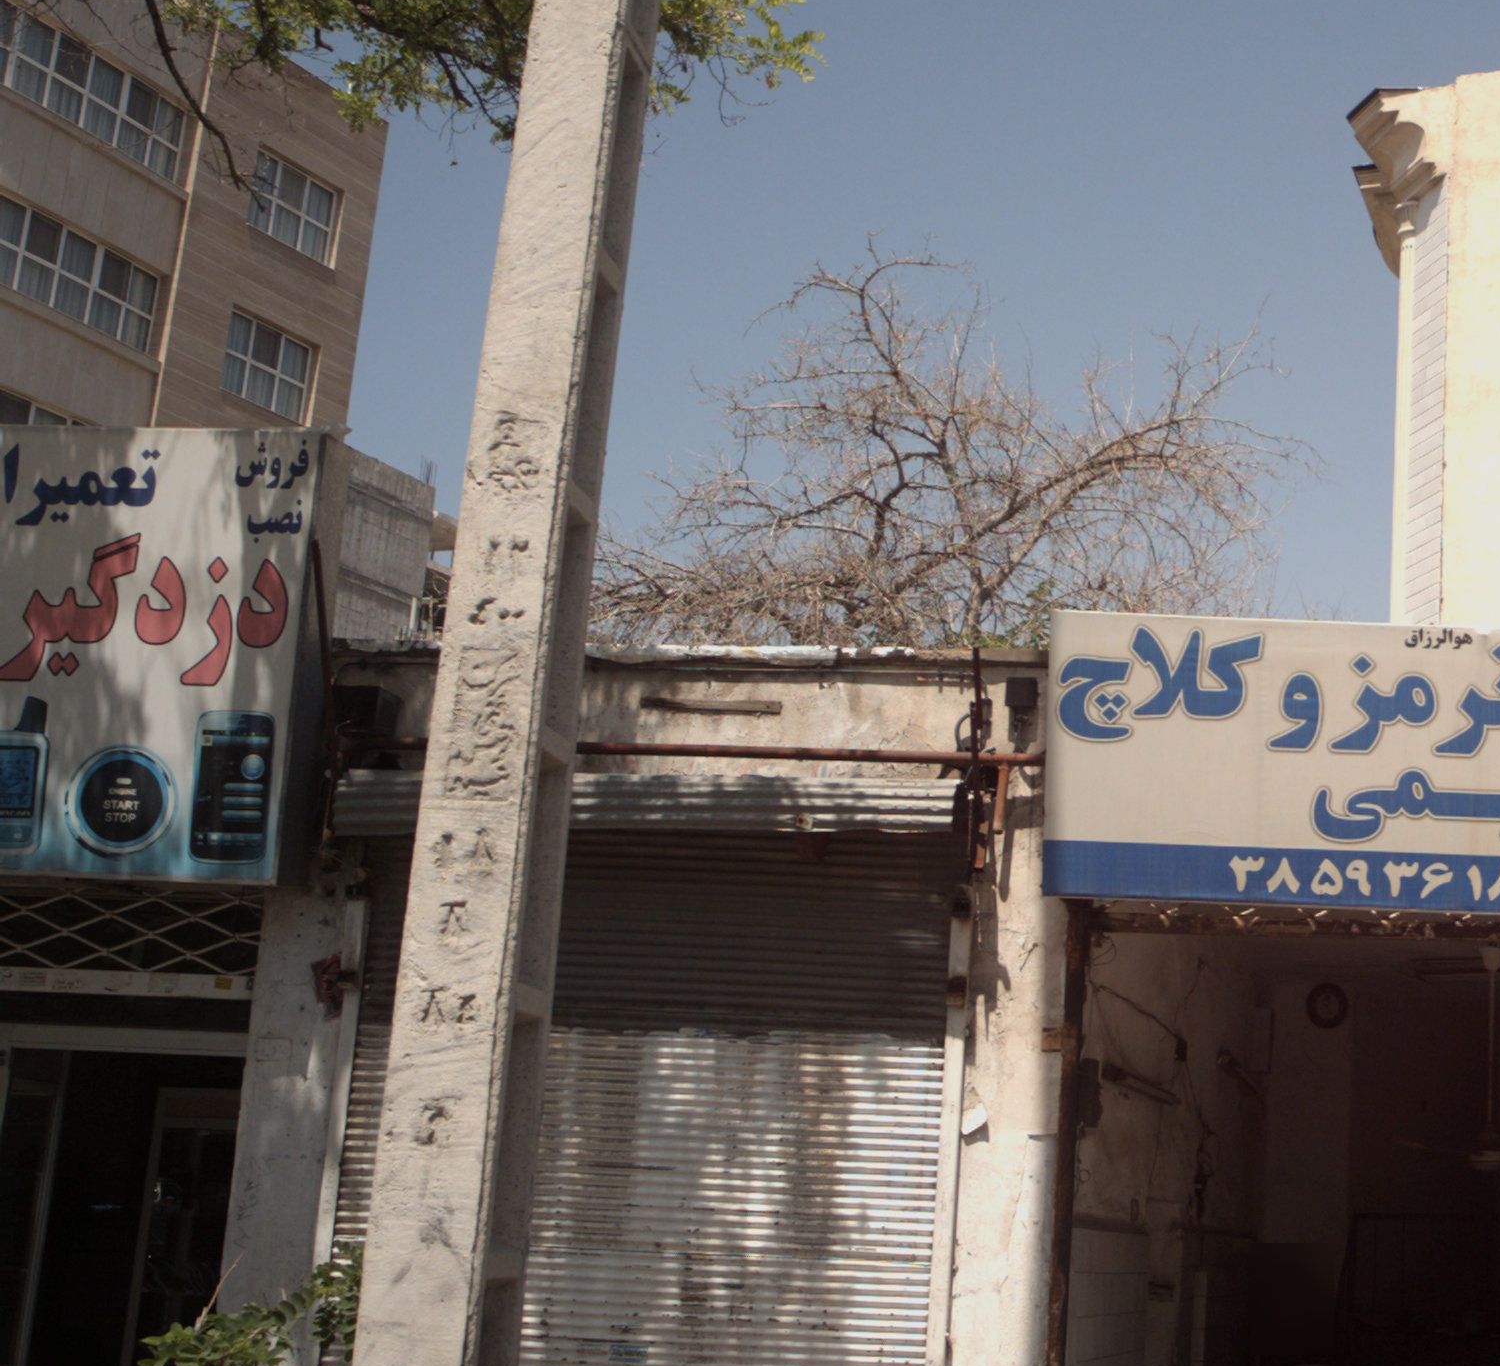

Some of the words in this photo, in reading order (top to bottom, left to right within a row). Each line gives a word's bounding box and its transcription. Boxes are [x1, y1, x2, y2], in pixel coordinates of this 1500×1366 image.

[234, 439, 311, 490] فروش
[246, 500, 305, 544] نصب
[0, 532, 290, 688] دزدگیر
[1403, 627, 1474, 650] هوالرزاق
[1055, 625, 1264, 743] کلاچ
[1267, 669, 1325, 752] و
[103, 799, 140, 811] START
[104, 812, 137, 823] STOP
